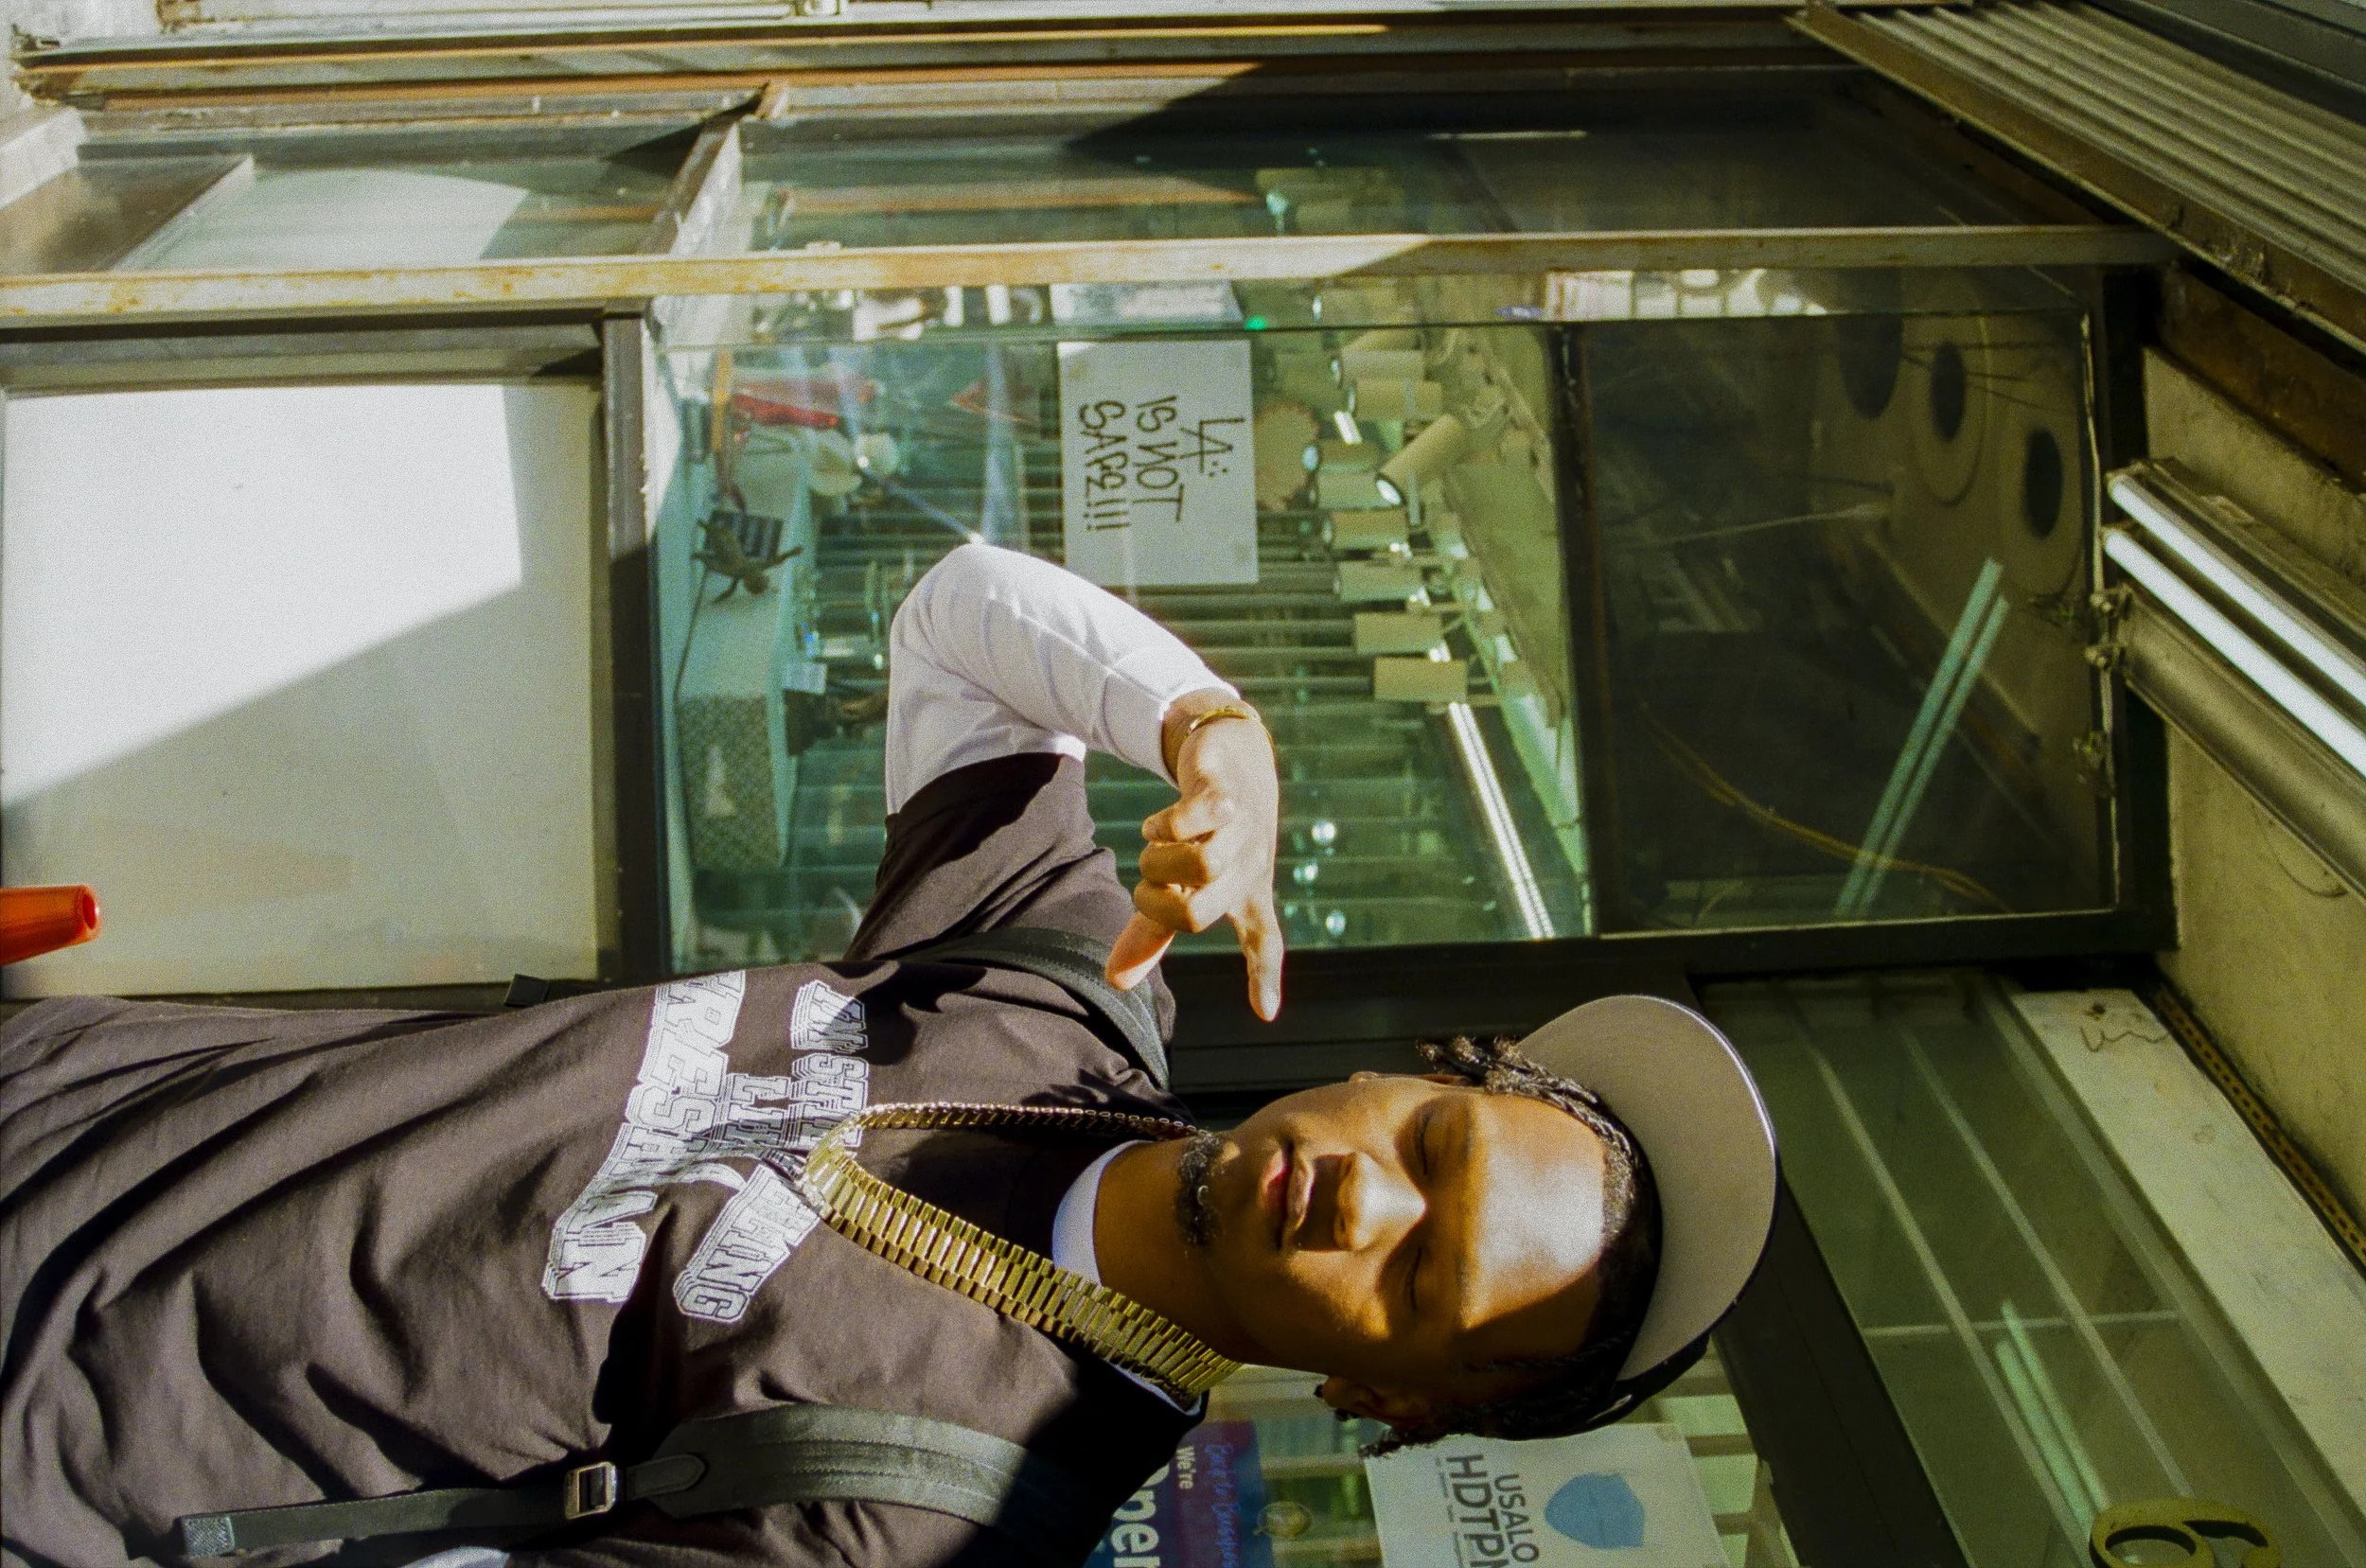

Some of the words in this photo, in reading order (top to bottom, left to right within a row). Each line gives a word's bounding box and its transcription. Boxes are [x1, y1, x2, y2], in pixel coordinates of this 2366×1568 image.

[1137, 395, 1177, 433] IS
[1132, 441, 1184, 522] NOT
[541, 970, 746, 1302] RESHAN
[715, 1072, 791, 1160] LIK
[1176, 1446, 1196, 1489] We're
